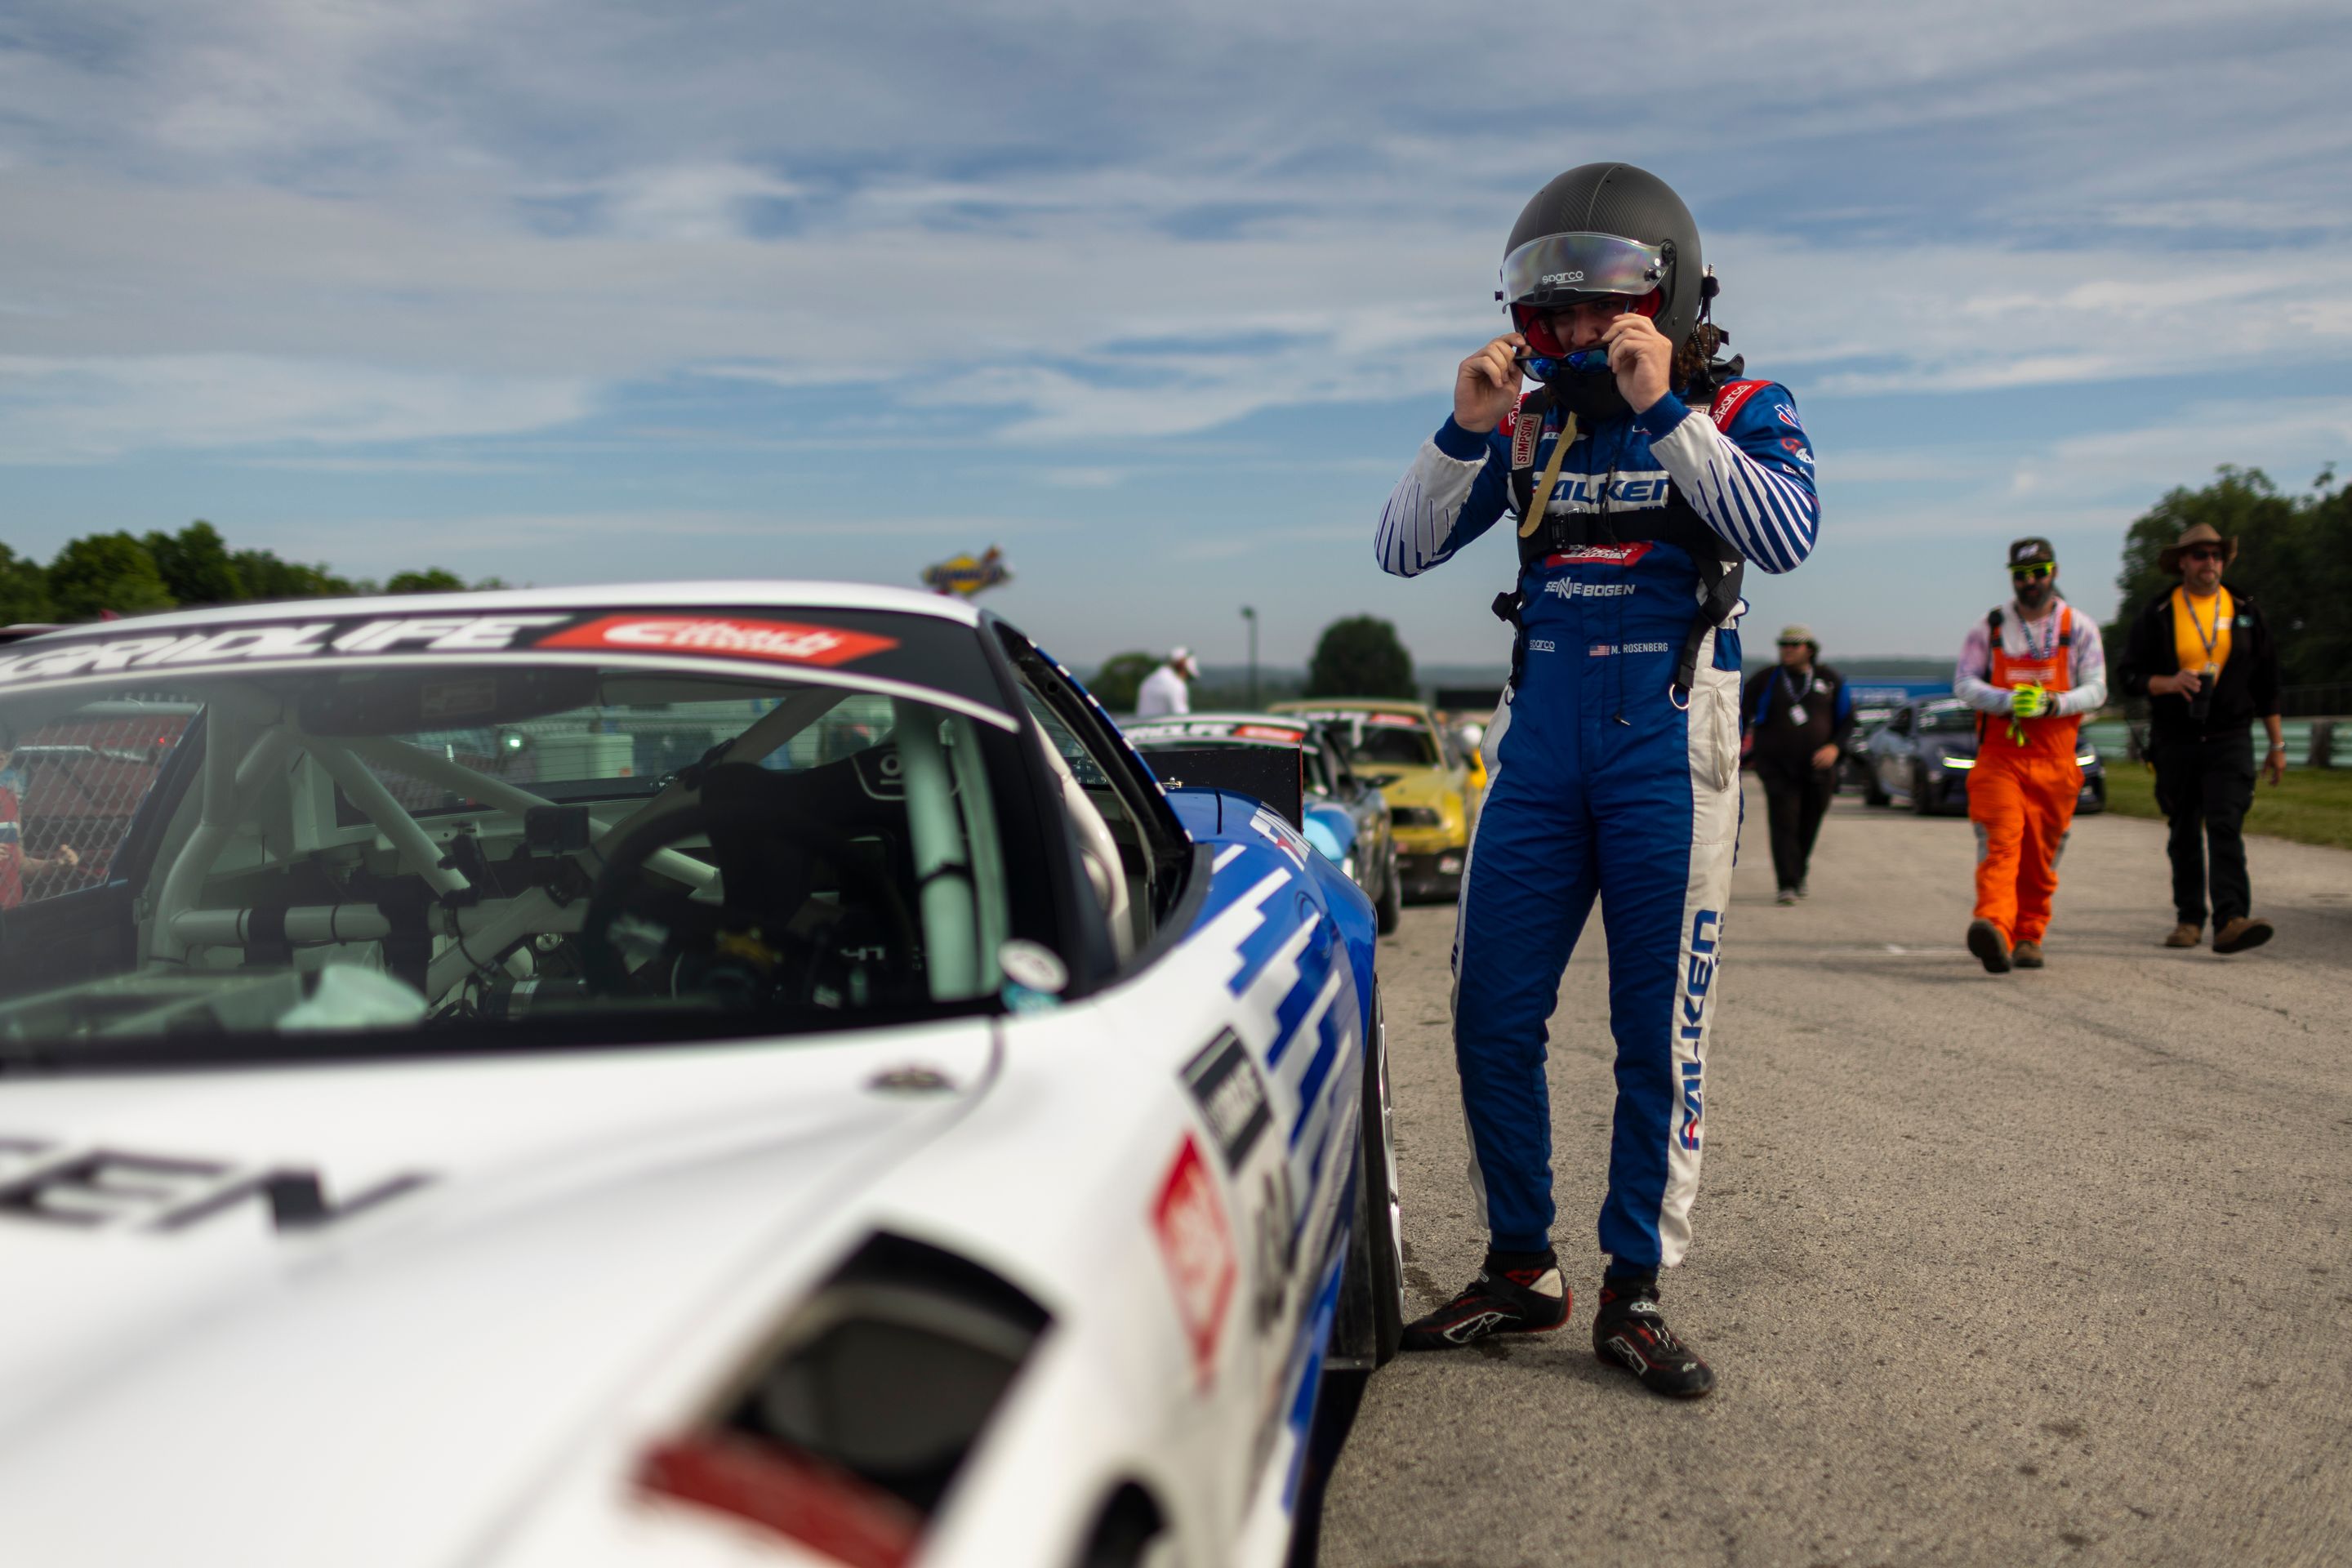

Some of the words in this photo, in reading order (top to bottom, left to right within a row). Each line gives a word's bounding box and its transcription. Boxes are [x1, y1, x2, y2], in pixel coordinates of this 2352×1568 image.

[1542, 270, 1584, 284] sparco
[1712, 385, 1752, 425] sparco
[1517, 418, 1535, 462] SIMPSON
[1533, 479, 1669, 505] ALKEN
[1544, 577, 1636, 599] SENNEBOGEN
[1529, 639, 1555, 653] sparco
[1610, 645, 1621, 654] M.
[1623, 643, 1668, 654] ROSENBERG
[1679, 909, 1718, 1158] FALKEN
